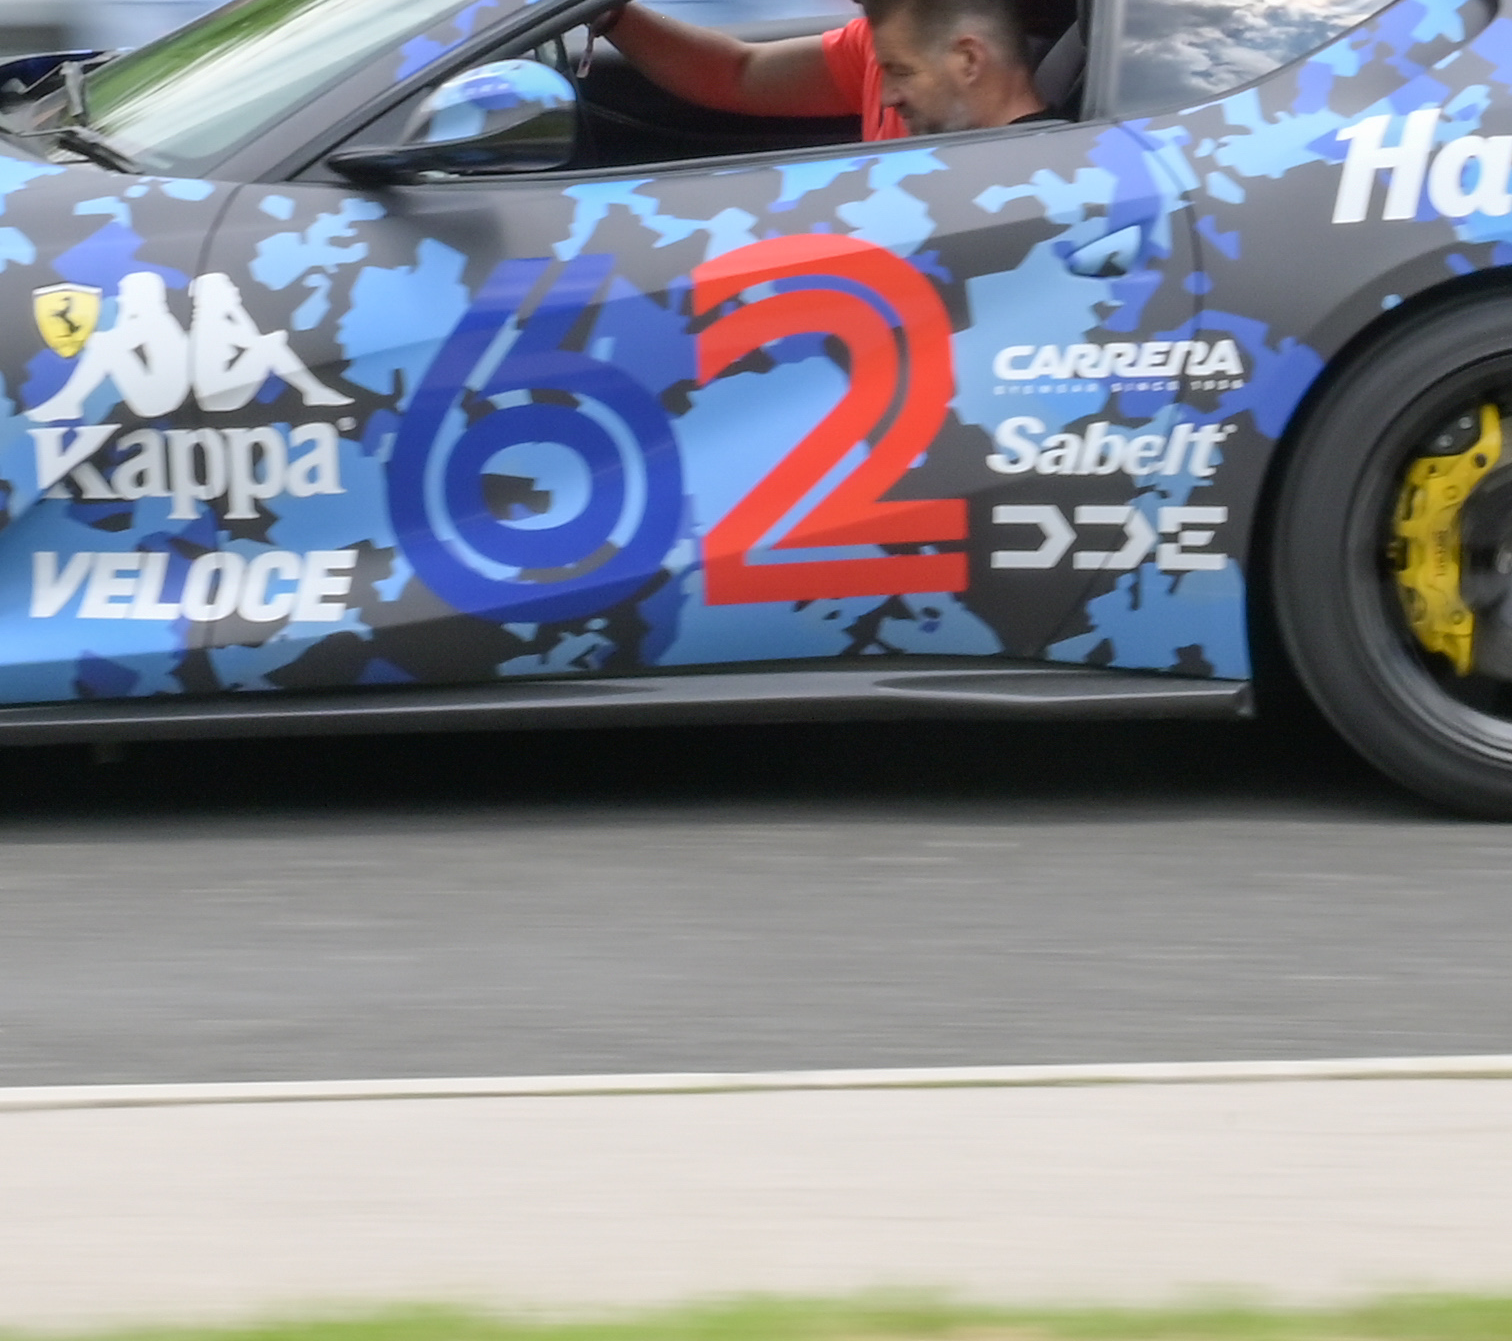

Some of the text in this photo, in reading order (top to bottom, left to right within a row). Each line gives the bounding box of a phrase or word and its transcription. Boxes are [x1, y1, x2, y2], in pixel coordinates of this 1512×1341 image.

[993, 339, 1244, 380] CARRERA
[386, 233, 968, 621] 62
[986, 416, 1228, 477] Sabelt
[27, 423, 347, 519] Kappa
[30, 549, 359, 622] VELOCE
